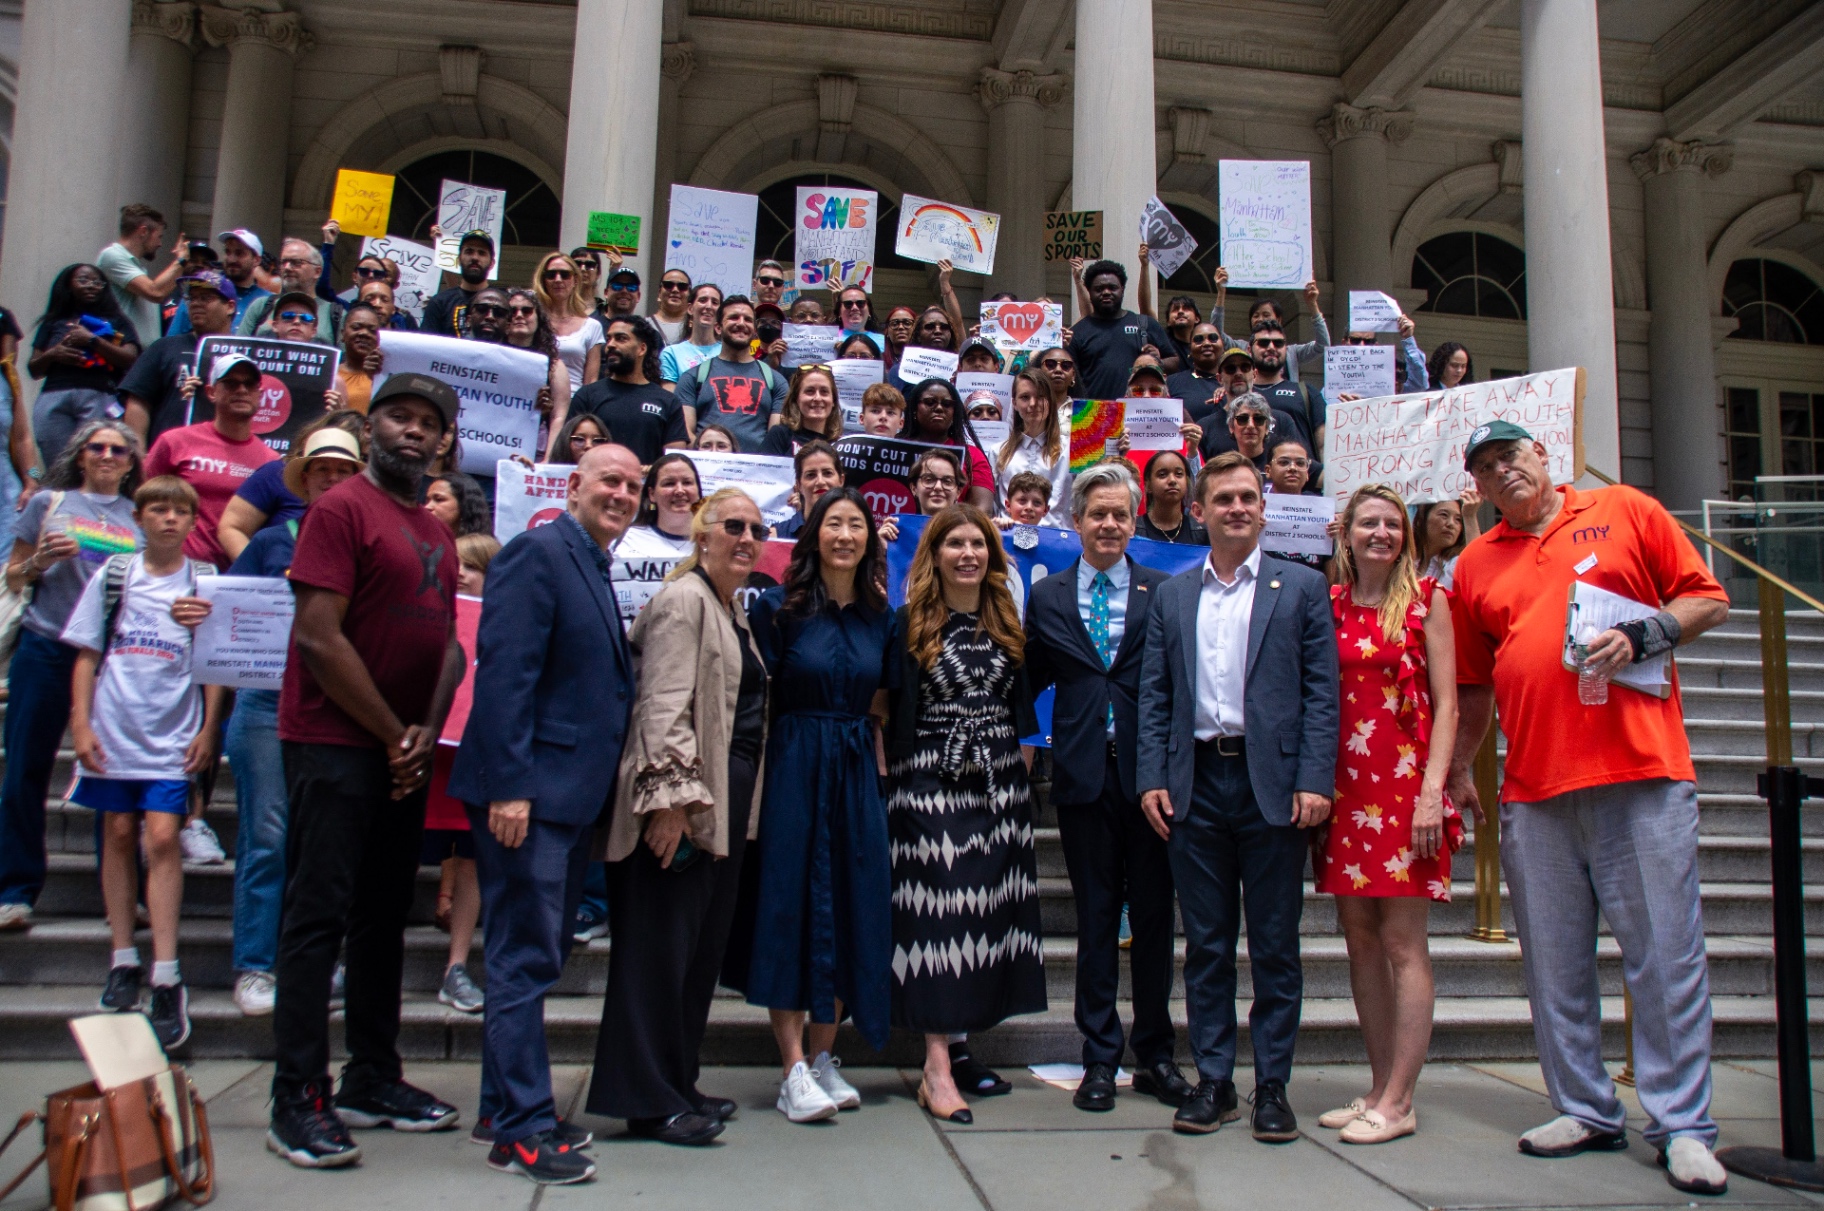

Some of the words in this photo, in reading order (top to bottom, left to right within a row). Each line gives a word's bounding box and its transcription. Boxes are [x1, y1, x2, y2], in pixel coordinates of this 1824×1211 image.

[803, 193, 869, 230] SAVE
[1046, 211, 1097, 230] SAVE
[800, 229, 870, 249] MANHATTAN
[1053, 230, 1087, 243] OUR
[1044, 241, 1101, 261] SPORTS
[801, 257, 872, 288] STAFF!
[211, 344, 251, 356] DON'T
[256, 349, 281, 359] CUT
[287, 351, 327, 365] WHAT
[298, 365, 321, 376] ON!
[430, 361, 499, 384] REINSTATE
[484, 391, 534, 411] YOUTH
[1334, 400, 1406, 430] DON'T
[1422, 391, 1476, 419] TAKE
[1484, 378, 1558, 408] AWAY
[1335, 418, 1478, 452] MANHATTAN
[1492, 402, 1573, 424] YOUTH
[458, 427, 522, 449] SCHOOLS!
[837, 443, 874, 456] DON'T
[880, 448, 908, 461] CUT
[873, 463, 909, 476] COUN
[1335, 448, 1433, 484] STRONG
[1265, 514, 1306, 522] MANHATTAN
[207, 660, 252, 668] REINSTATE
[239, 671, 277, 679] DISTRICT
